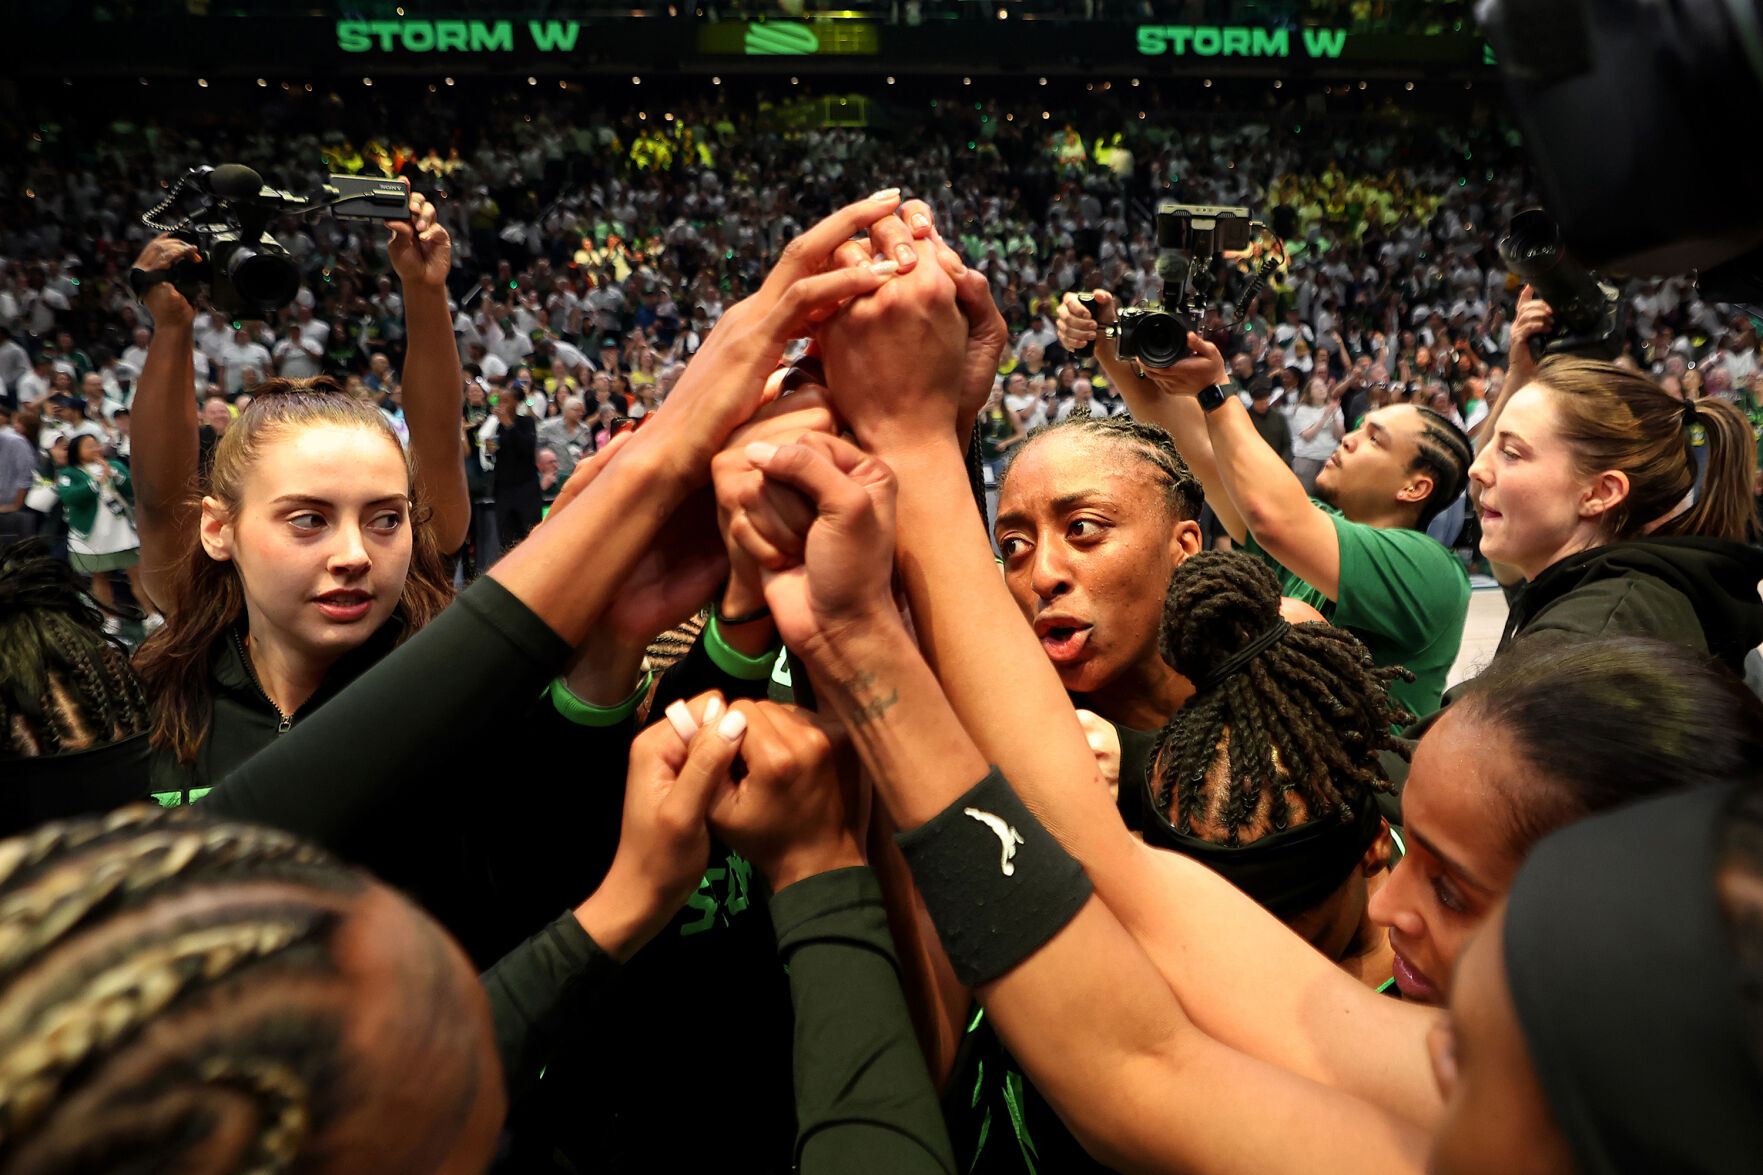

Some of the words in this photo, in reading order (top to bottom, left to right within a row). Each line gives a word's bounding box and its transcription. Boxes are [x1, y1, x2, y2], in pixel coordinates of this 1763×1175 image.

[338, 21, 512, 51] STORM
[530, 21, 579, 50] W
[1138, 27, 1288, 56] STORM
[1304, 29, 1346, 57] W
